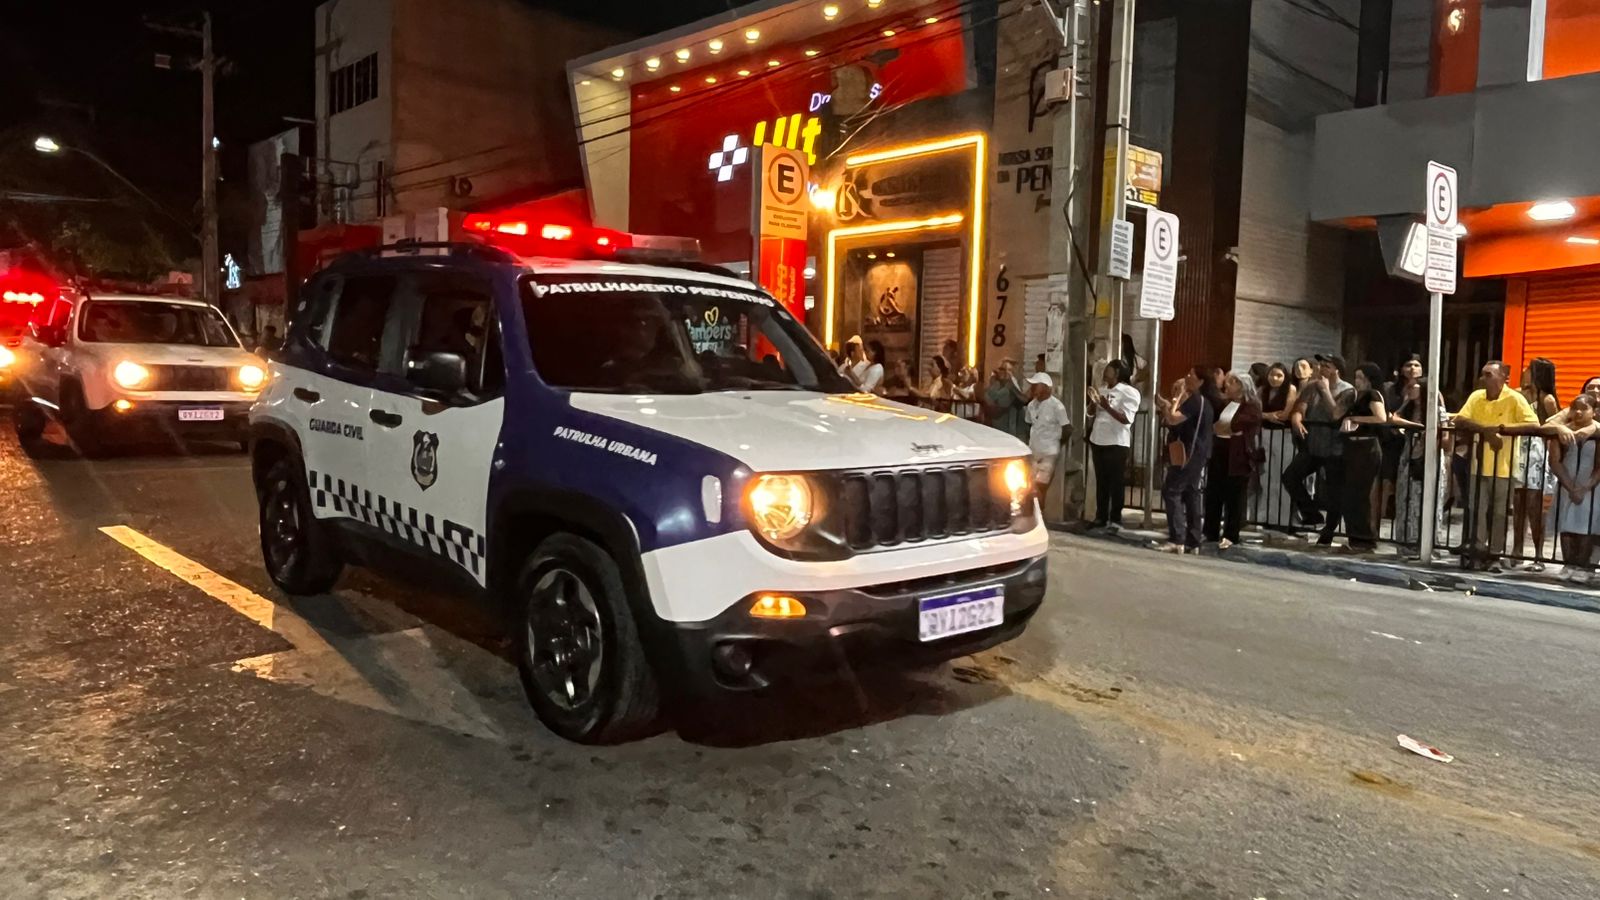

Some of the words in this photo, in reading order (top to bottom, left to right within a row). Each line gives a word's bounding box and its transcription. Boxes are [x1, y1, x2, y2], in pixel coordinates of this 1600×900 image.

[777, 163, 795, 195] E
[1438, 185, 1446, 212] E
[1158, 227, 1167, 251] E
[535, 280, 688, 298] PATRULHAMENTO
[689, 285, 776, 308] PREVENTIVO
[309, 418, 342, 435] GUARDA
[343, 423, 364, 441] CIVIL
[552, 425, 608, 450] PATRULHA
[607, 440, 658, 466] URBANA
